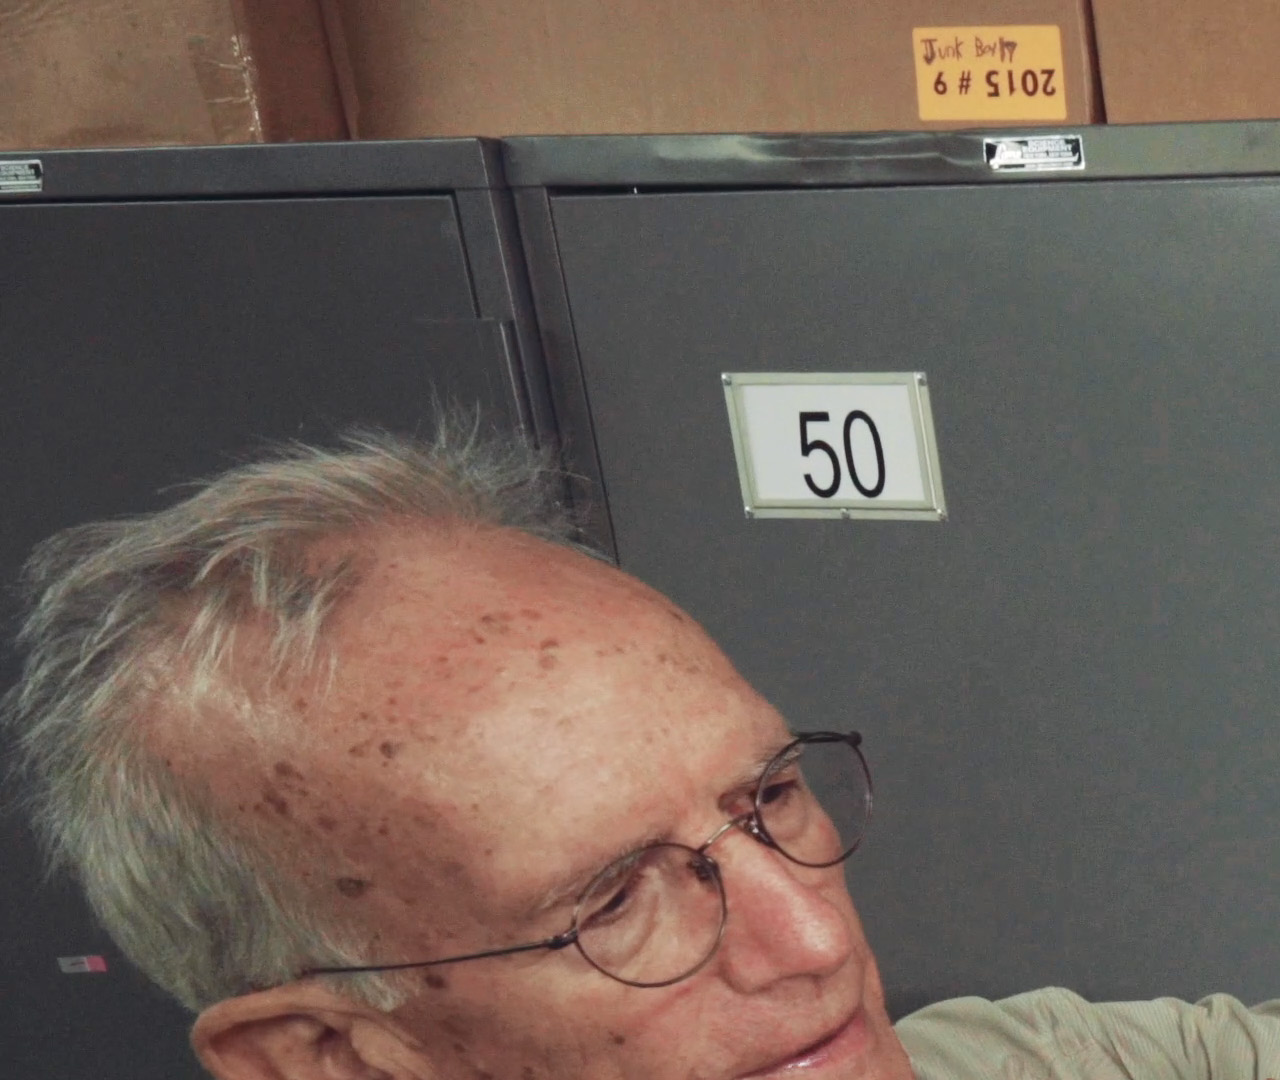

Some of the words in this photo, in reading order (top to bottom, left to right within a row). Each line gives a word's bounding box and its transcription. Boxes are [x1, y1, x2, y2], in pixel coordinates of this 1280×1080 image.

[920, 36, 964, 65] Junk
[985, 69, 1056, 97] 2015
[799, 409, 885, 498] 50
